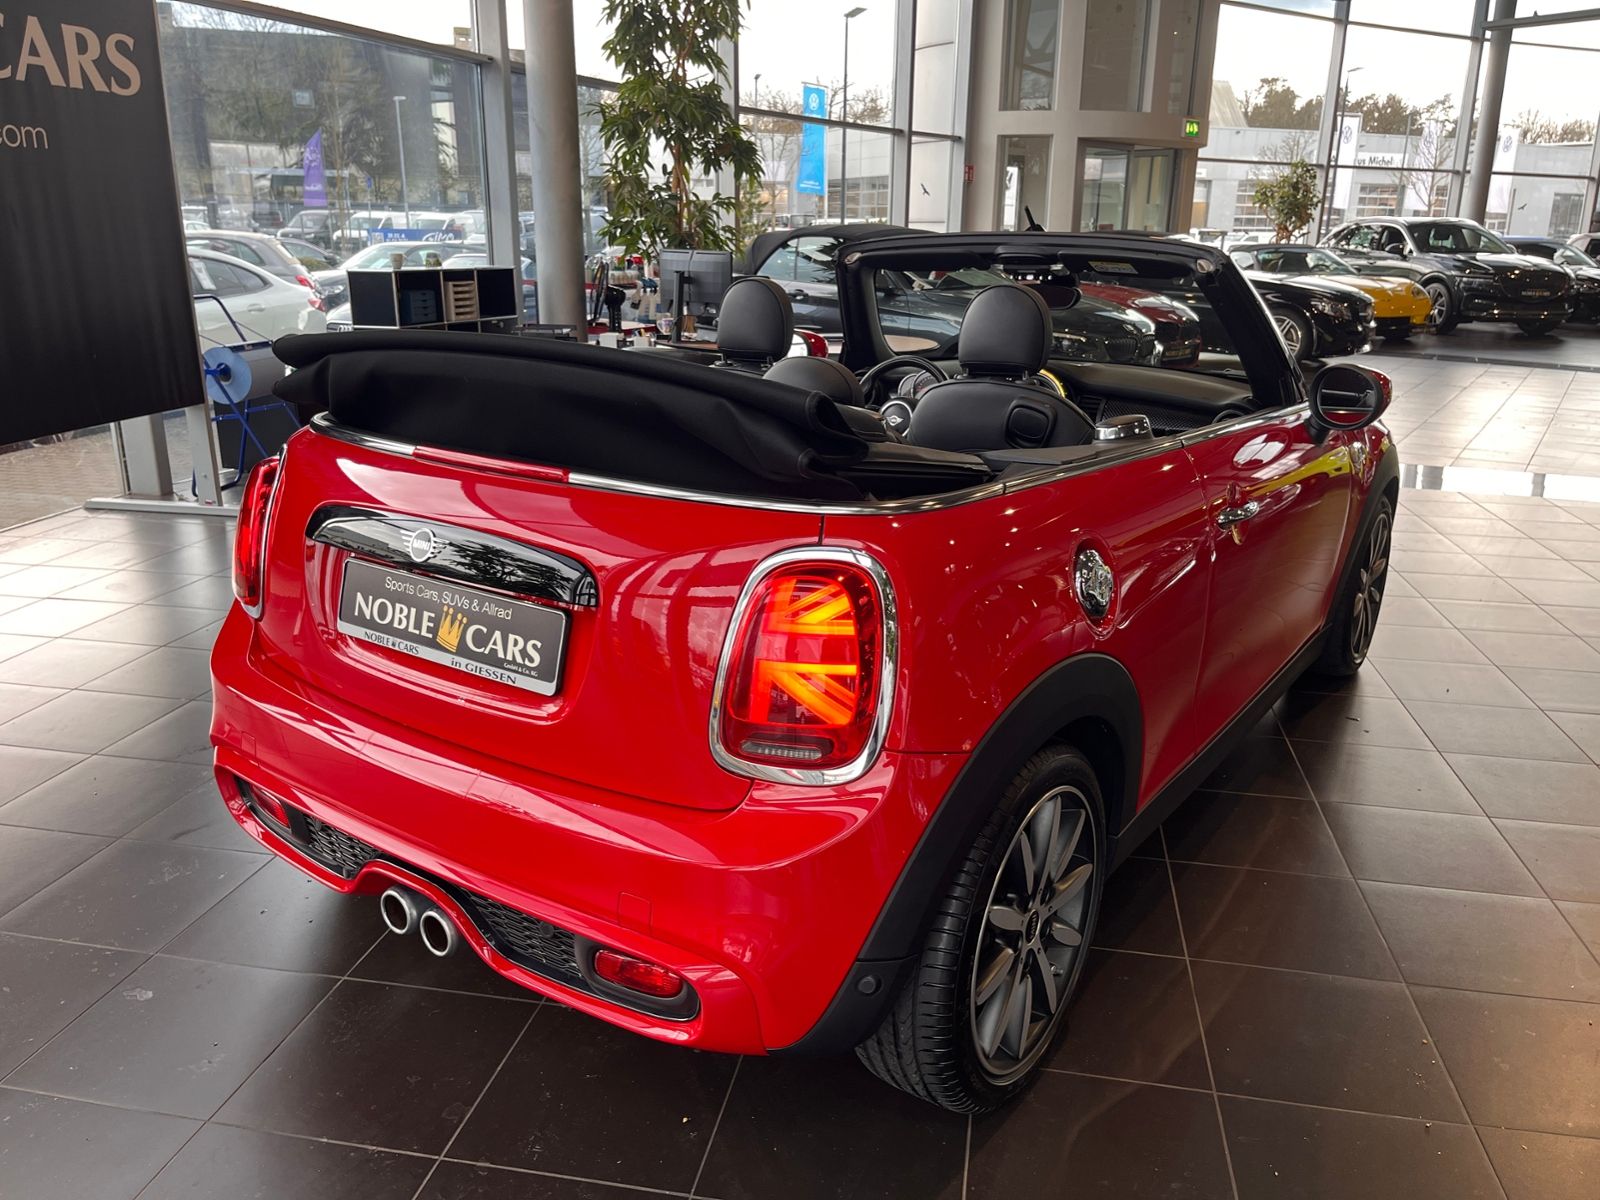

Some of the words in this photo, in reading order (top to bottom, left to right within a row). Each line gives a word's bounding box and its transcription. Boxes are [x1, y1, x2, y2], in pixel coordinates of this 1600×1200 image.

[0, 124, 49, 150] om
[412, 538, 431, 551] MINI
[385, 576, 415, 595] Sports
[416, 584, 440, 604] Cars,
[441, 591, 470, 609] SUVs
[471, 598, 480, 612] &
[481, 601, 513, 620] Allrad
[354, 591, 436, 639] NOBLE
[465, 624, 543, 668] CARS
[364, 631, 391, 647] NOBLE
[397, 641, 421, 655] CARS
[450, 657, 462, 668] in
[464, 662, 517, 684] GIESSEN
